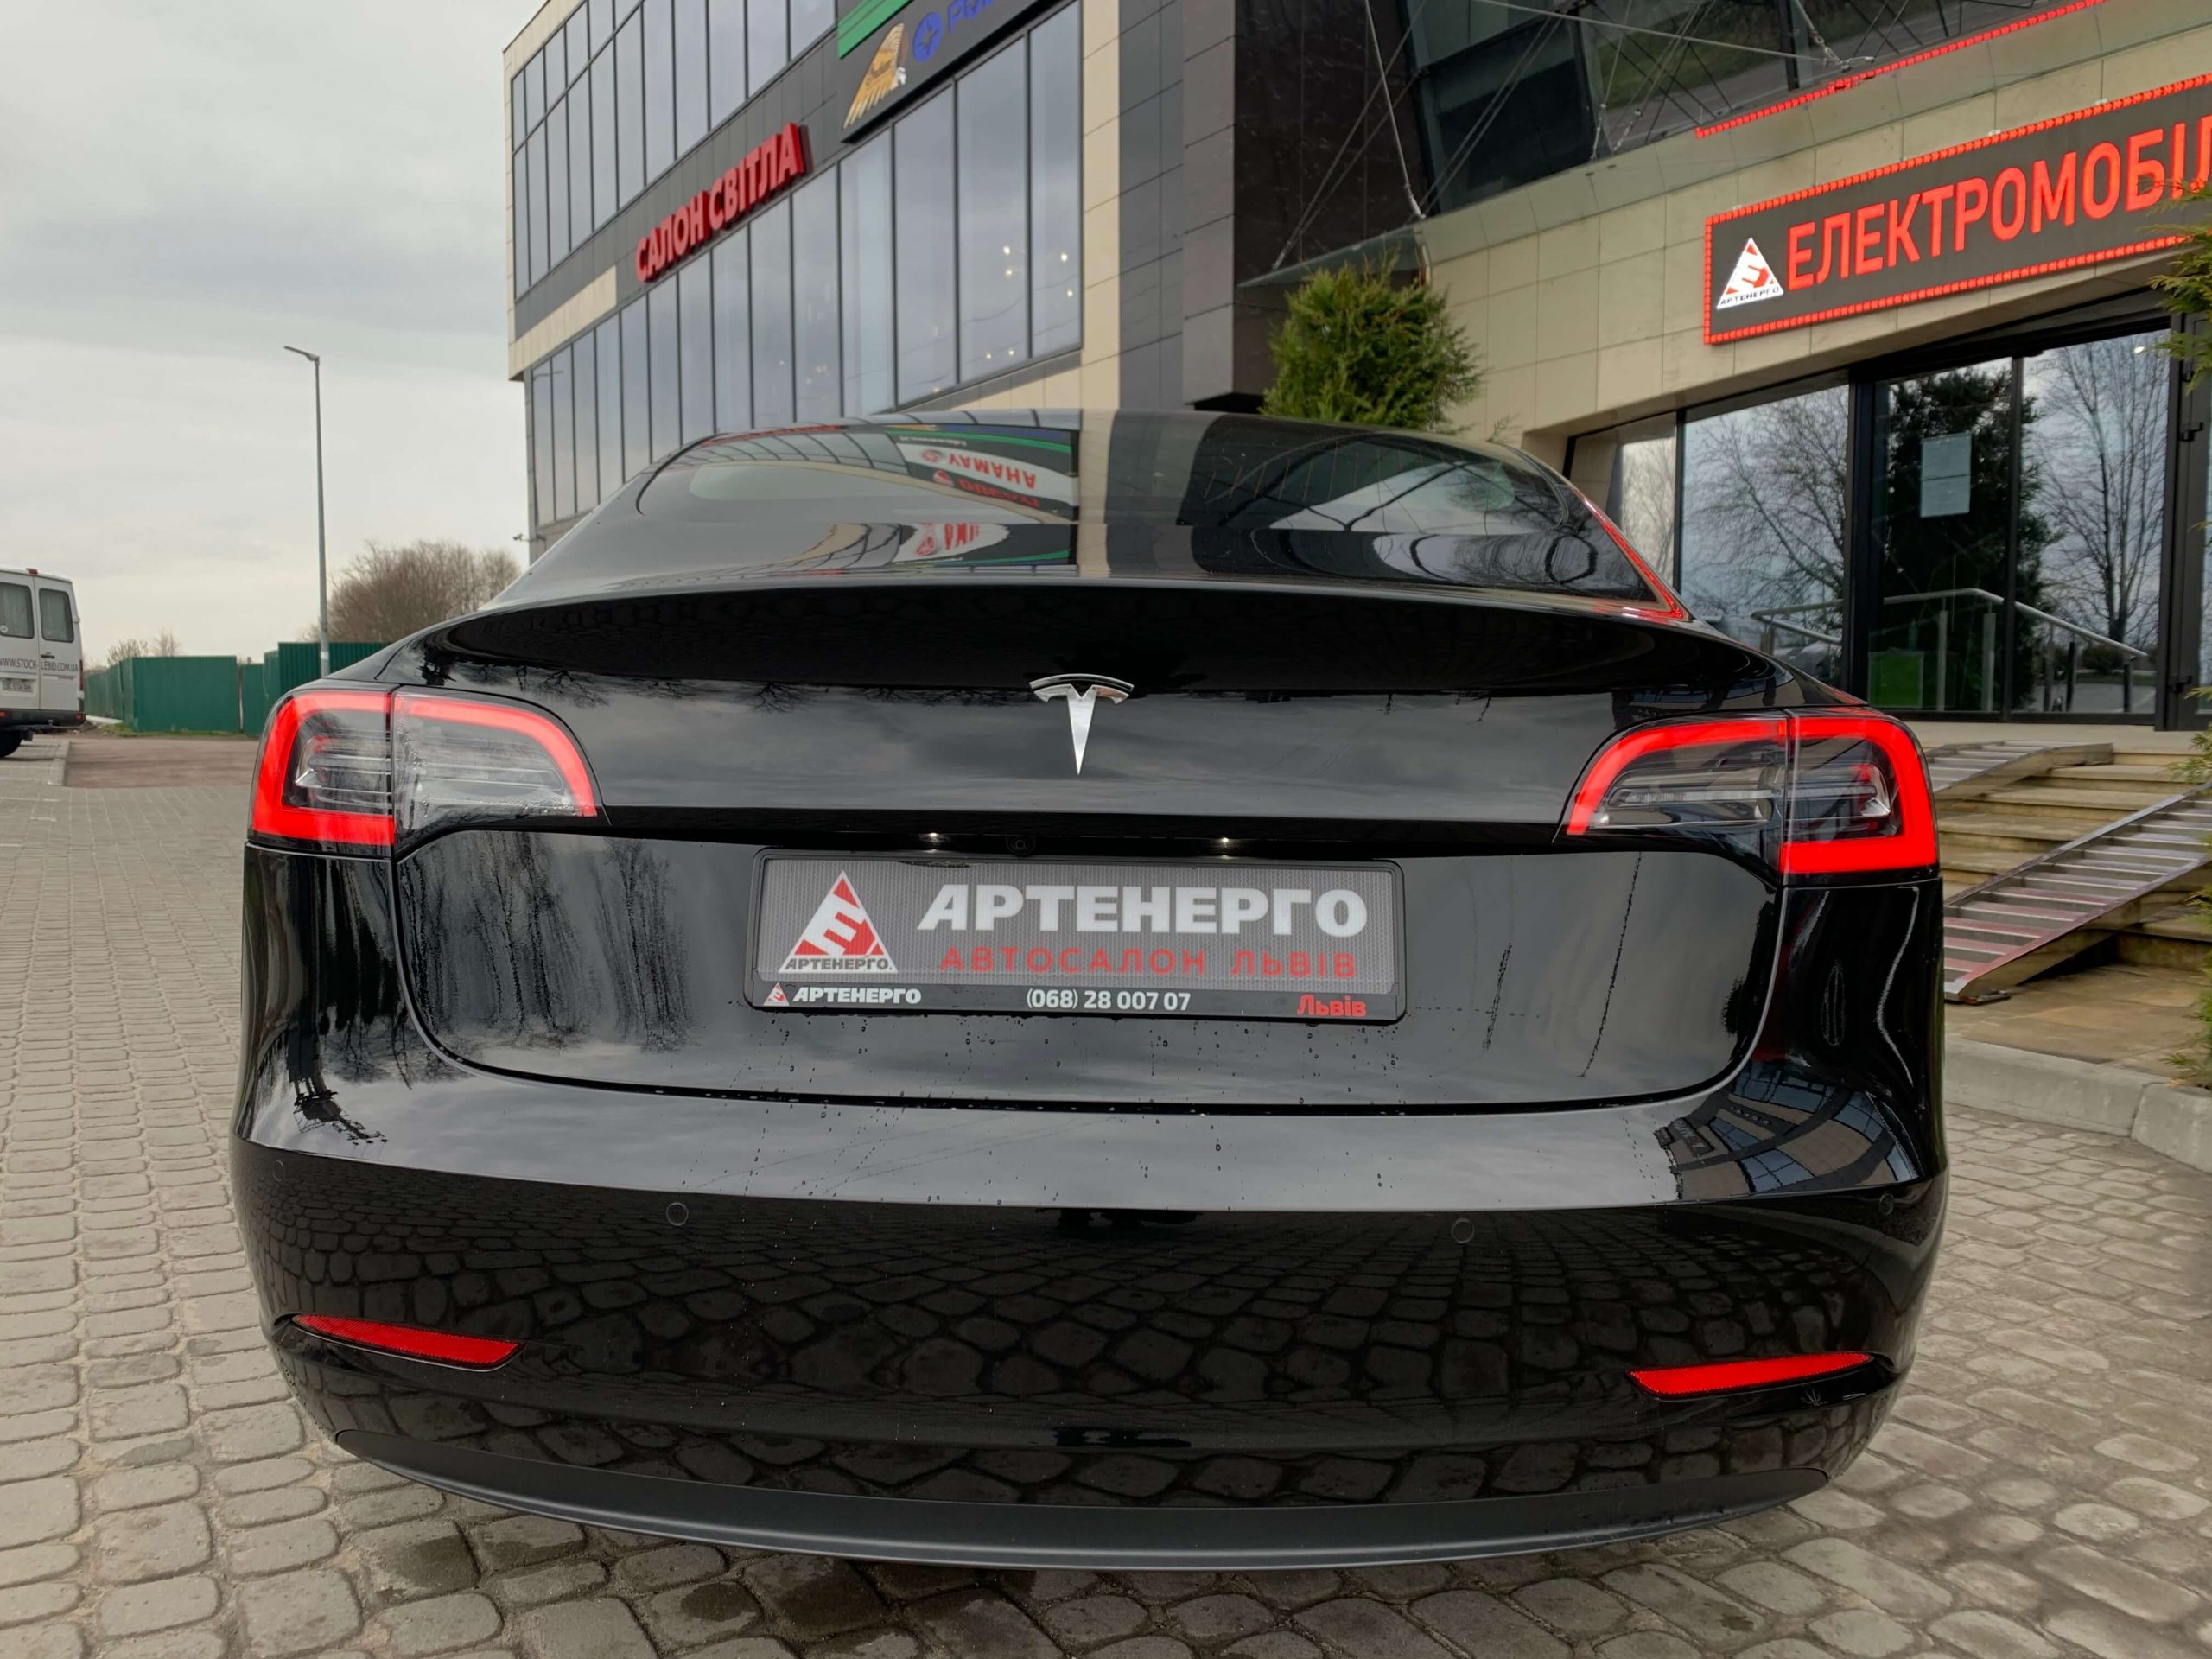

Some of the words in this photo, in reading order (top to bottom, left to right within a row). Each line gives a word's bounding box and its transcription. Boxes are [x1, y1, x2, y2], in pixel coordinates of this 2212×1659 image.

[947, 0, 995, 31] PO
[636, 190, 711, 283] САЛОН
[709, 123, 805, 231] СВІТЛА
[1720, 286, 1781, 306] АРТЕНЕРГО
[917, 884, 1367, 938] АРТЕНЕРГО
[939, 945, 1206, 976] АВТОСАЛОН
[1230, 950, 1356, 978] ЛЬВІВ
[792, 987, 921, 1004] АРТЕНЕРГО
[1027, 988, 1079, 1009] (068)
[1084, 991, 1111, 1009] 28
[1297, 995, 1367, 1017] Львів
